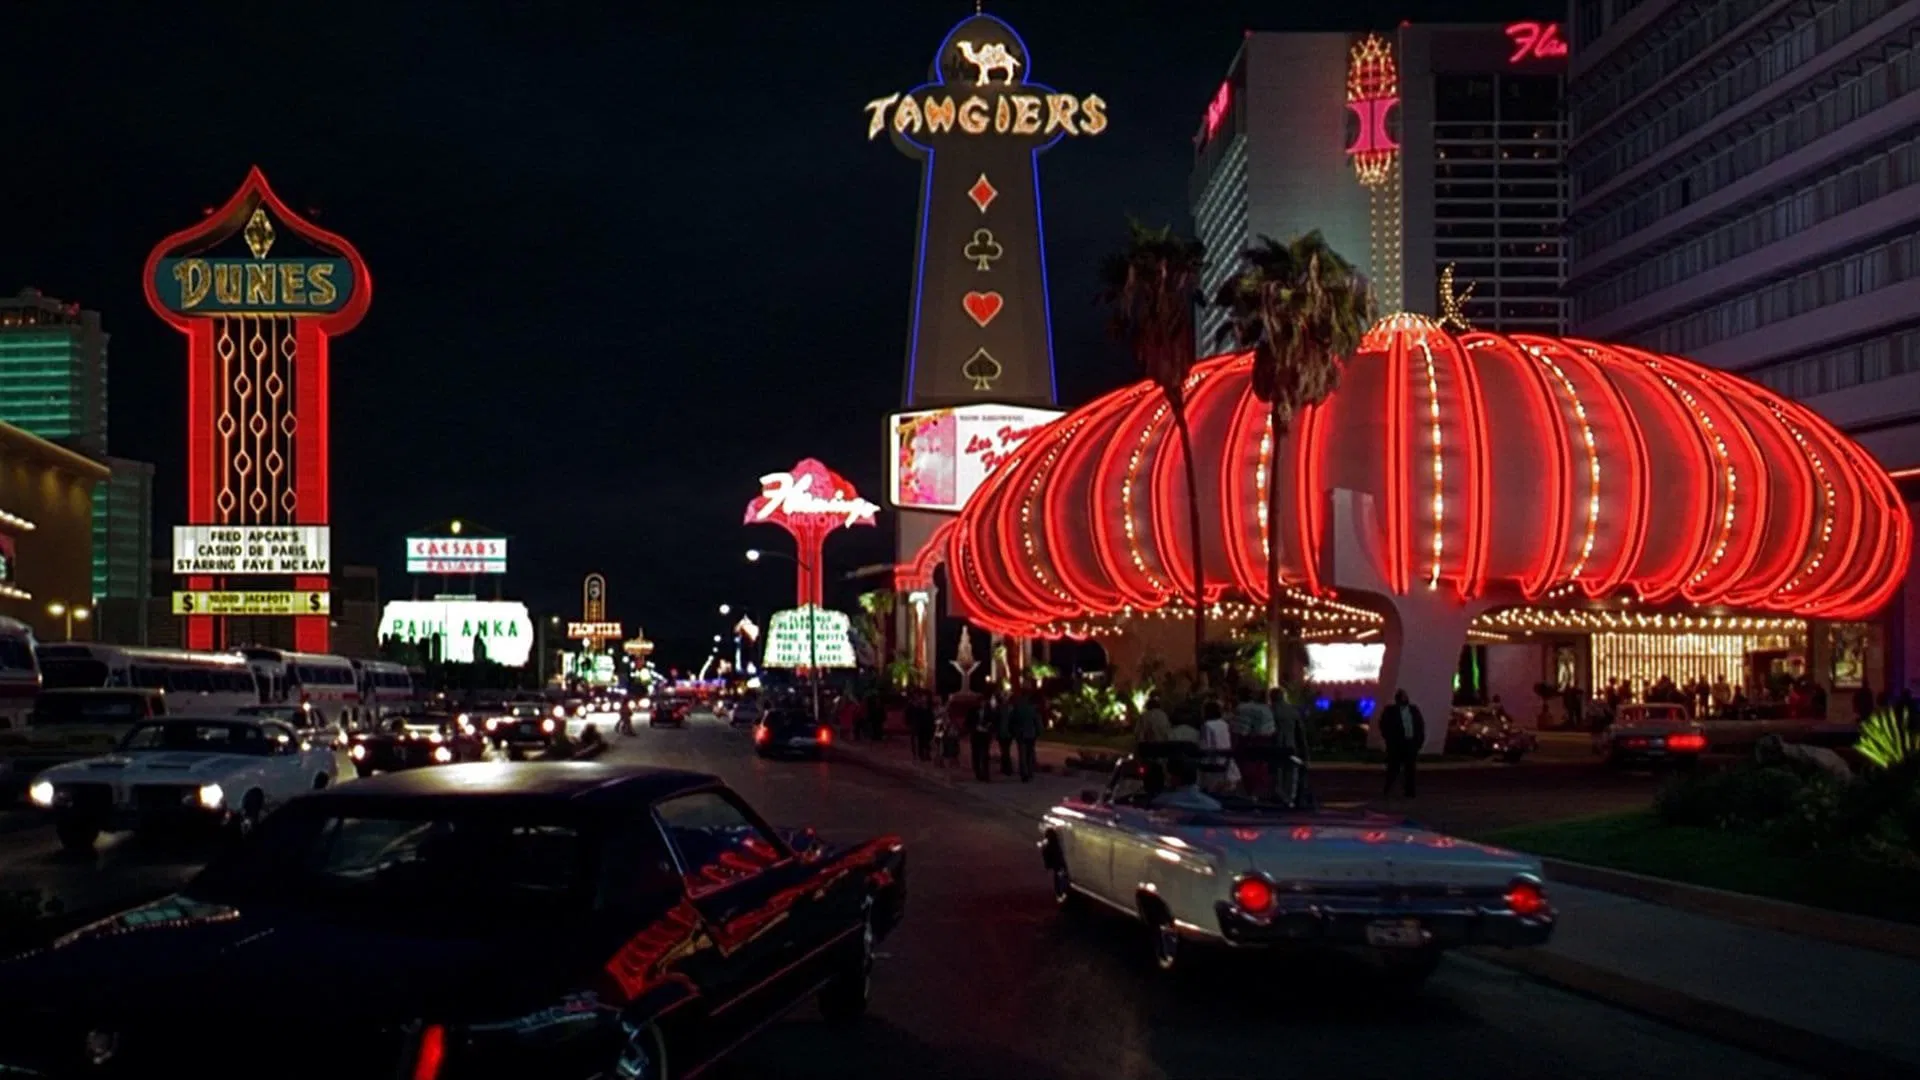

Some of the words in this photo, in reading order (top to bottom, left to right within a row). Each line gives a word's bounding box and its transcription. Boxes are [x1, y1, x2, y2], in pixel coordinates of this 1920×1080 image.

[864, 92, 1108, 140] TANGIERS
[173, 258, 337, 310] DUNES
[757, 472, 880, 528] Flamingo
[211, 531, 241, 542] FRED
[198, 545, 242, 556] CASINO
[248, 545, 264, 556] DE
[272, 545, 307, 556] PARIS
[416, 542, 497, 555] CAESARS
[177, 559, 236, 570] STARRING
[242, 559, 274, 570] FAYE
[393, 619, 448, 638] PAUL
[462, 619, 518, 637] ANKA
[805, 633, 845, 641] BNEFITS
